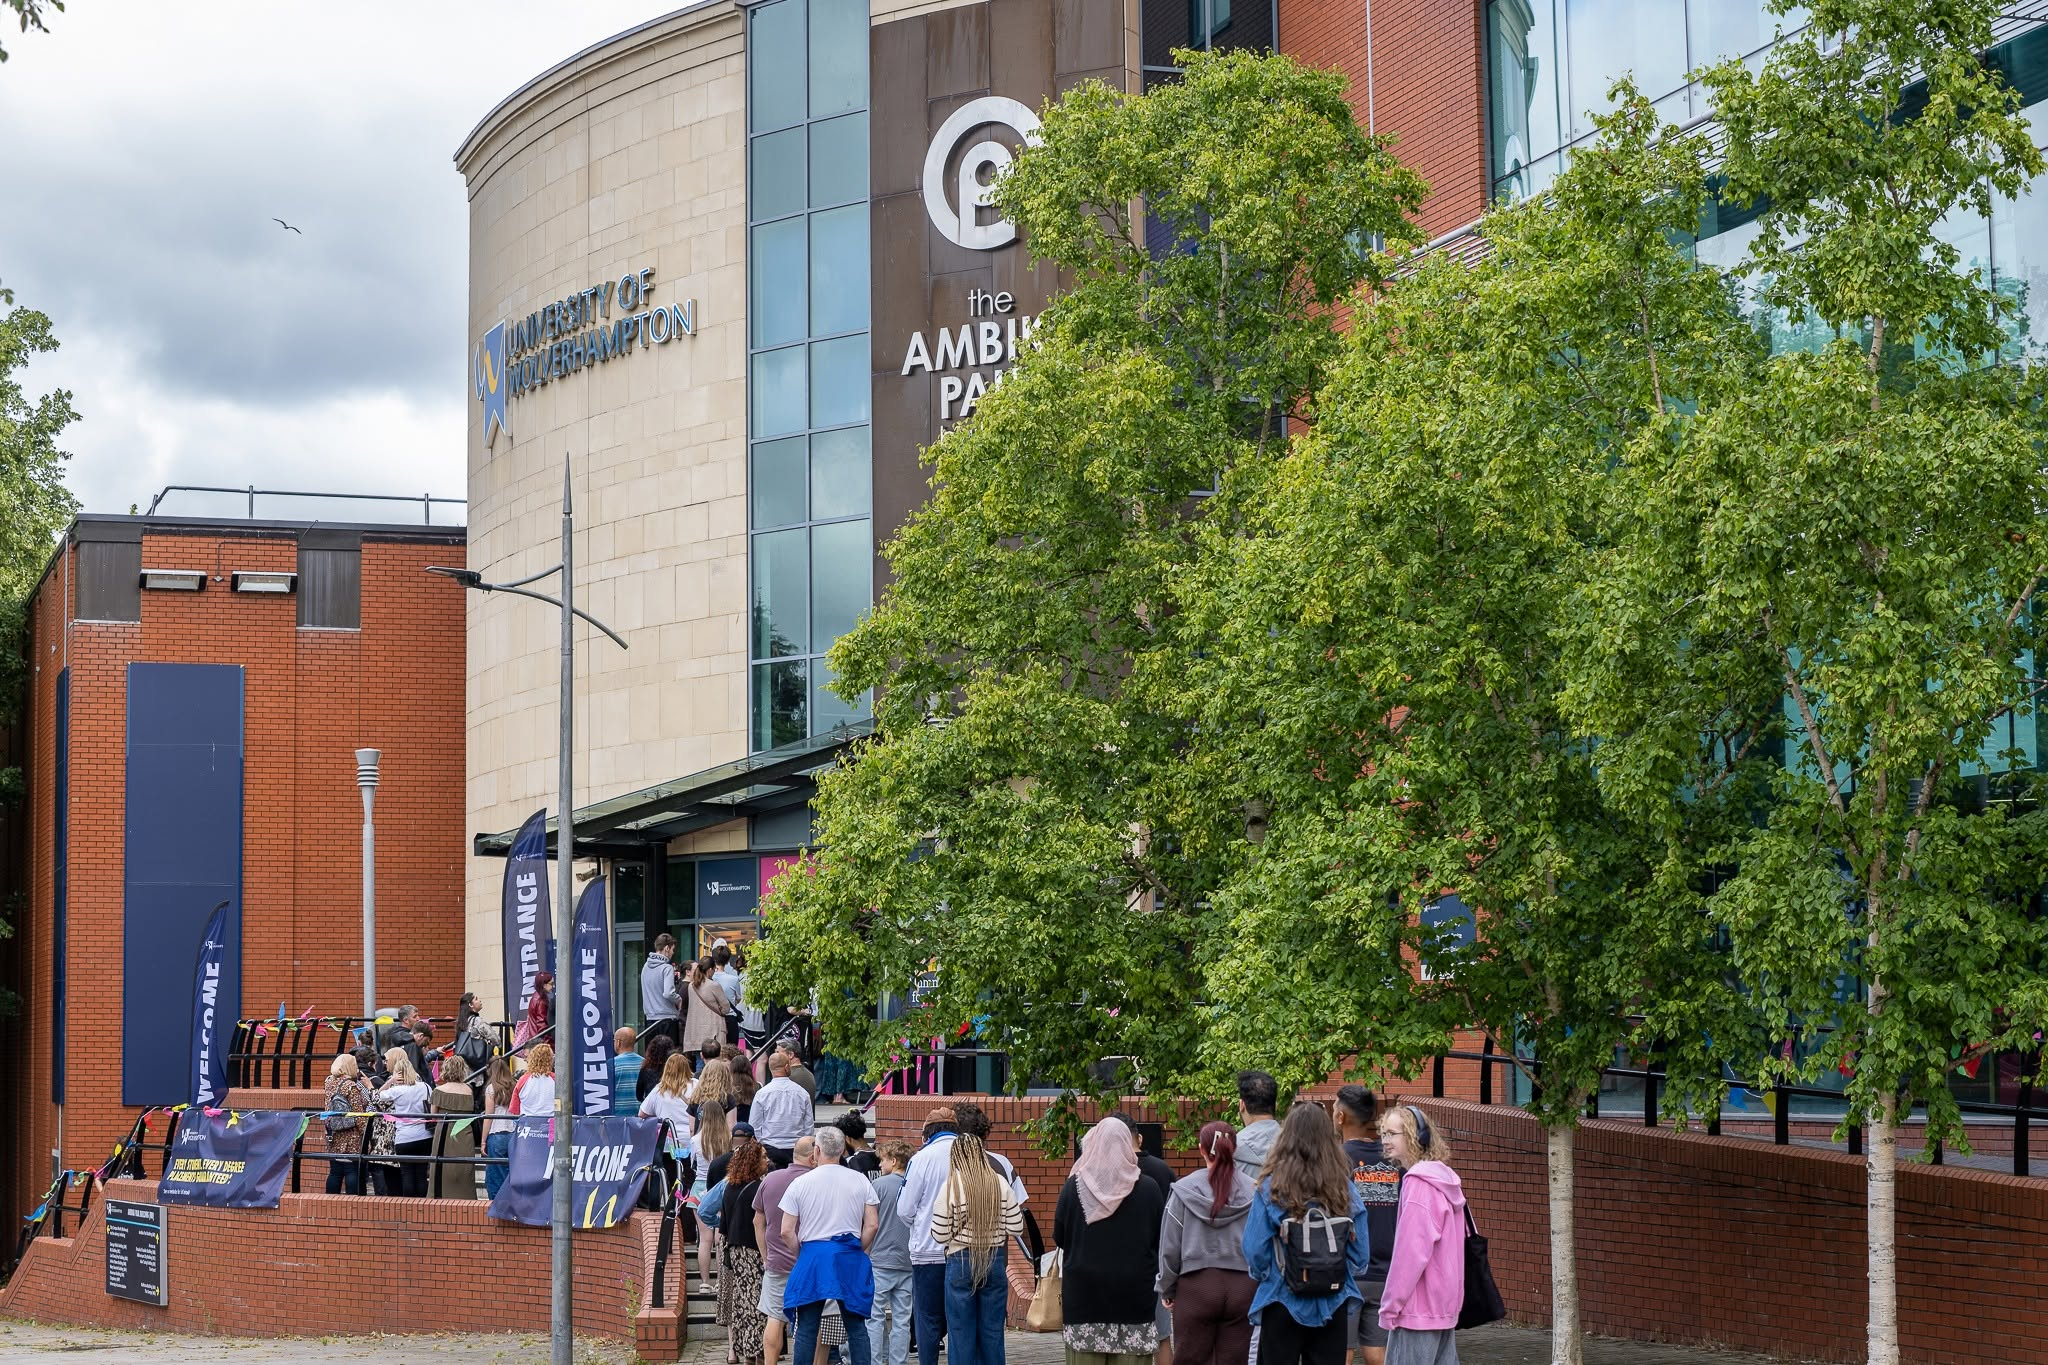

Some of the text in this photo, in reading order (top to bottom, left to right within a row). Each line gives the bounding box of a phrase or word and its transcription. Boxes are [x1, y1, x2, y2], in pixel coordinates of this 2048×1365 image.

[507, 267, 655, 359] UNIVERSITY OF
[508, 299, 697, 398] WOLVERHAMPTON
[967, 288, 1014, 317] the
[516, 872, 539, 1011] ENTRANCE
[197, 961, 220, 1105] WELCOME
[581, 948, 610, 1116] WELCOME
[203, 1158, 225, 1171] EVERY
[223, 1160, 246, 1173] DEGREE
